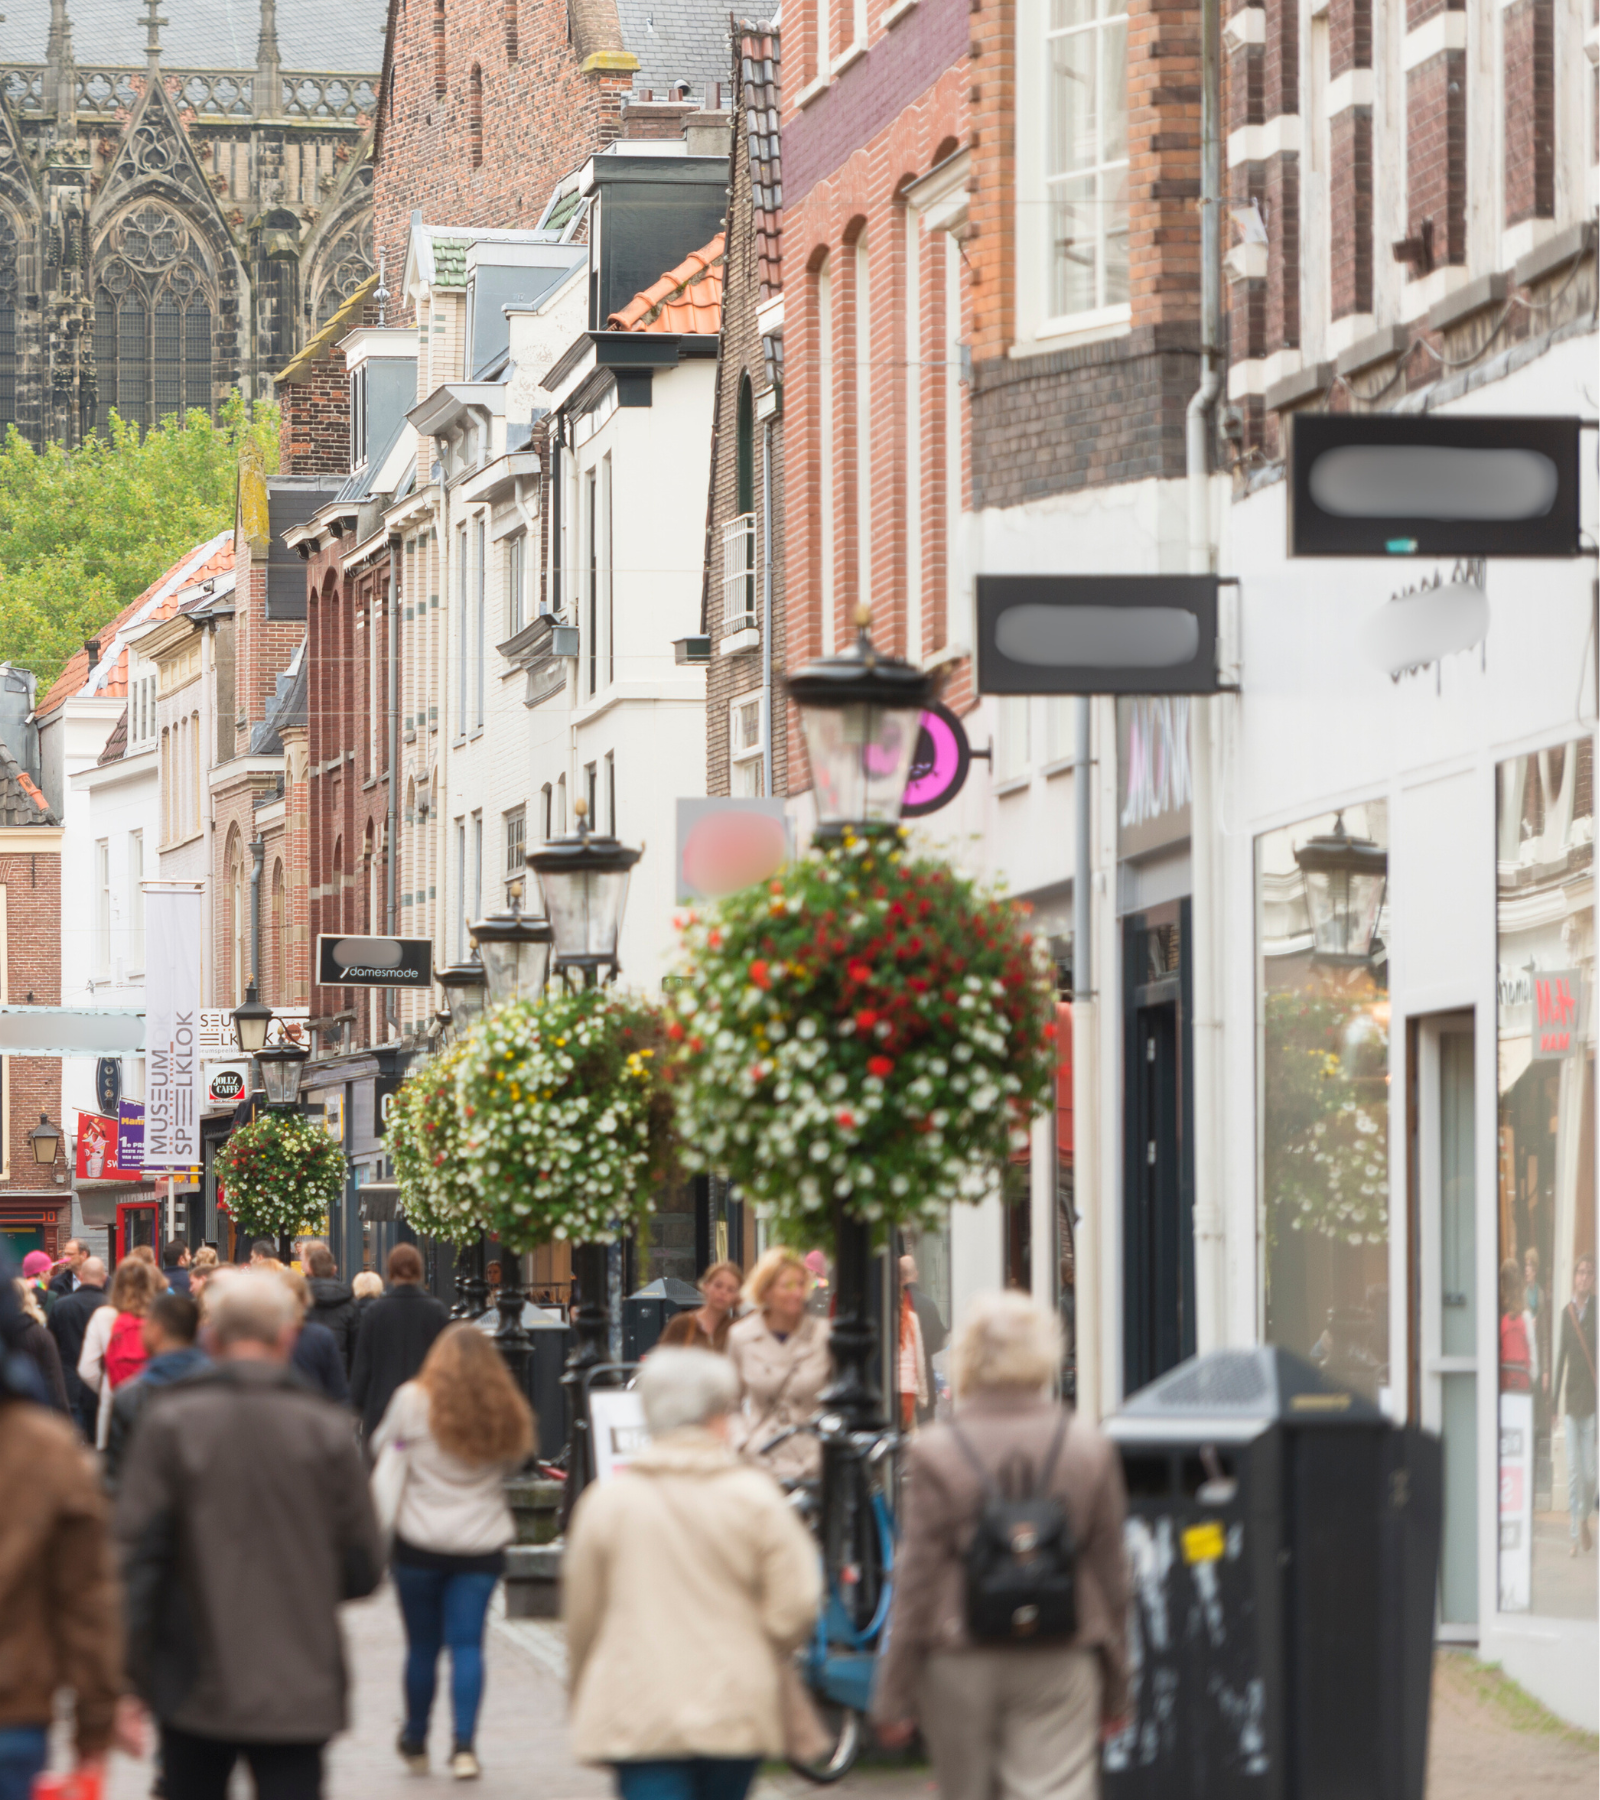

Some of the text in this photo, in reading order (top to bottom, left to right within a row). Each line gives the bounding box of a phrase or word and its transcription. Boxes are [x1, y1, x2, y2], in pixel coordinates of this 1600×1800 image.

[349, 966, 419, 978] damesmode
[213, 1076, 238, 1086] JOLLY
[150, 1050, 169, 1155] MUSEUM
